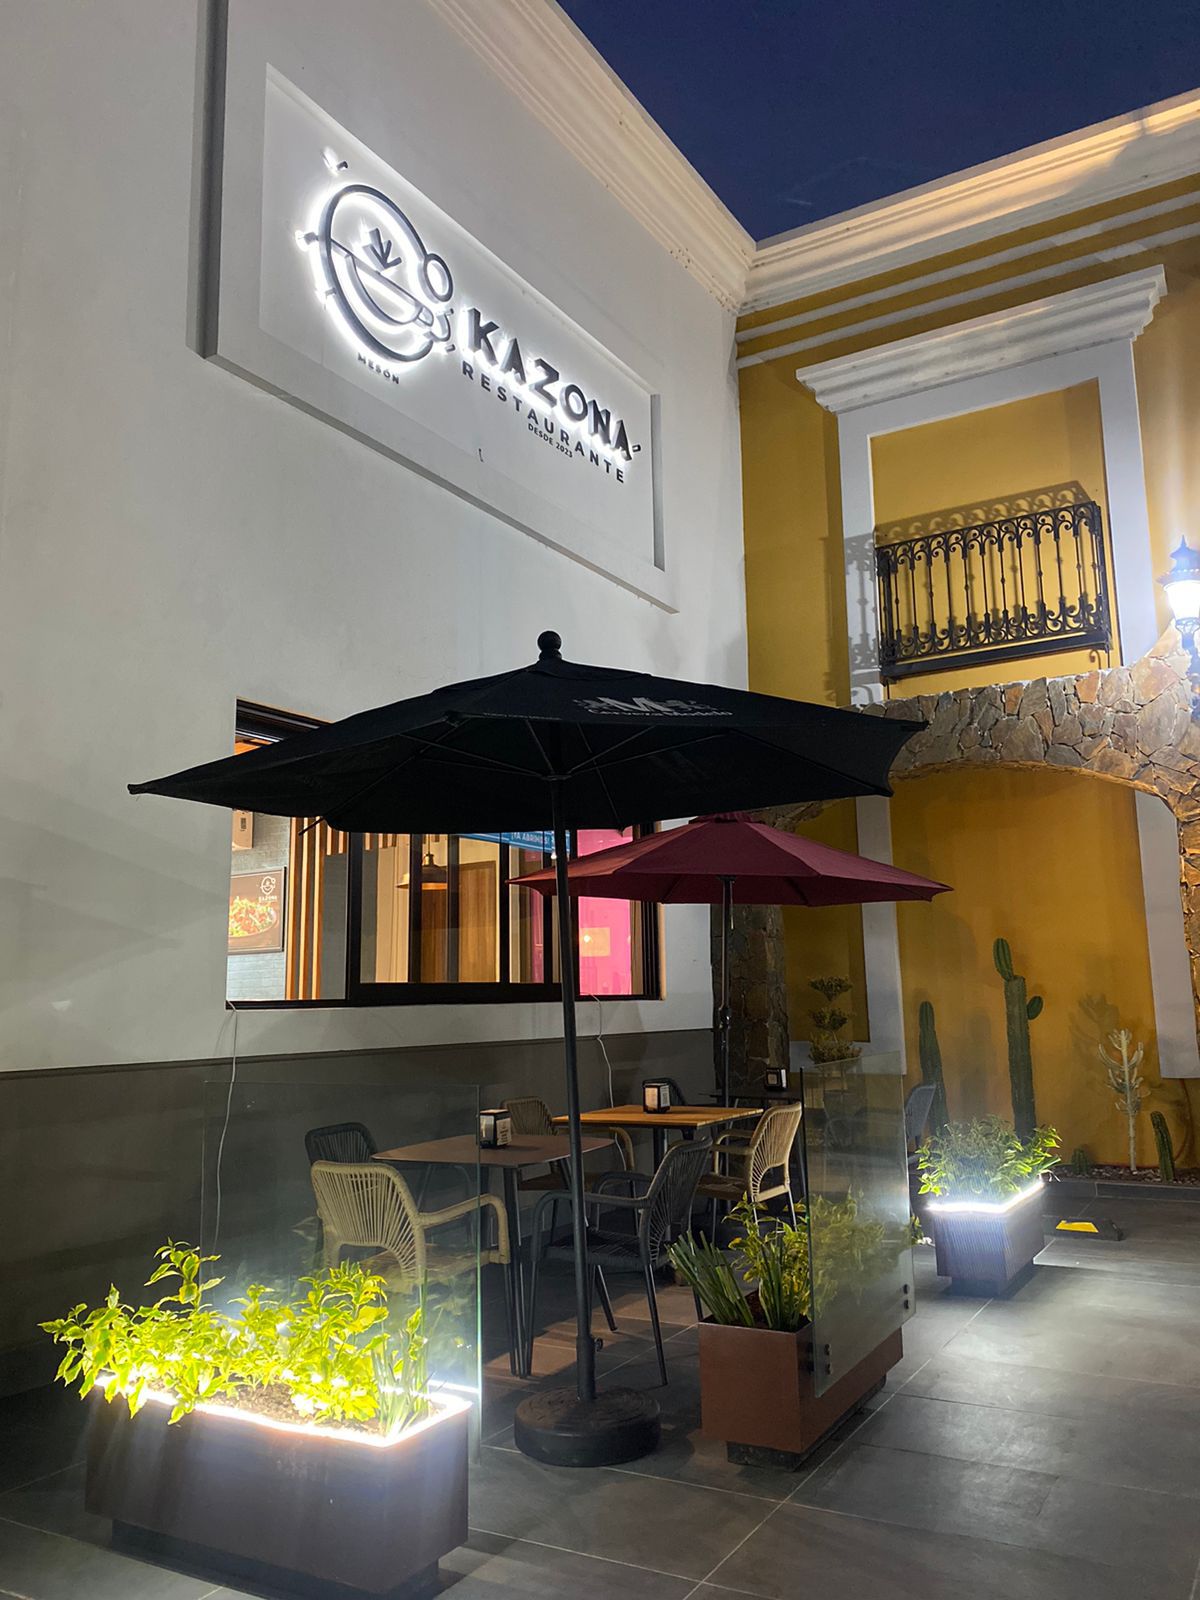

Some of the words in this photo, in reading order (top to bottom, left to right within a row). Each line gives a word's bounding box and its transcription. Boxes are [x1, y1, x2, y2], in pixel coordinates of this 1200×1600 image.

[463, 360, 624, 483] RESTAURANTE
[468, 308, 632, 461] KAZONA
[528, 423, 554, 447] DESDE
[555, 442, 573, 458] 2023
